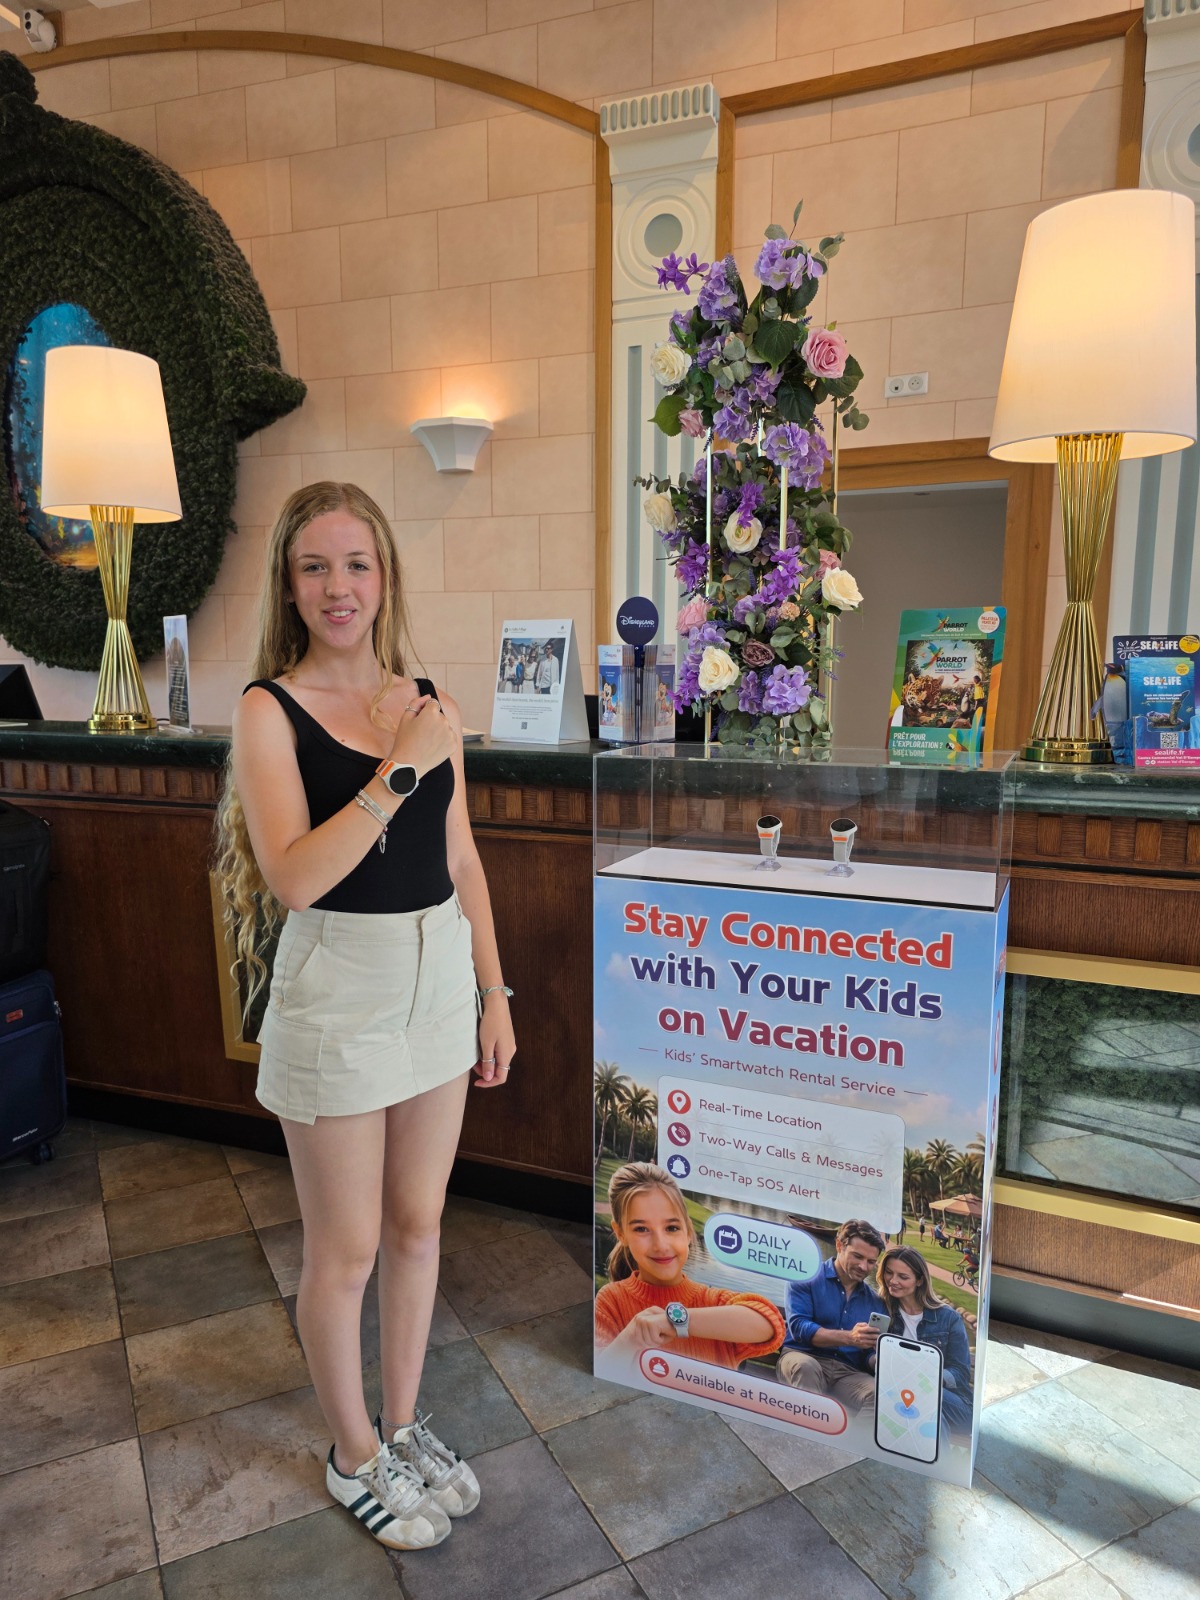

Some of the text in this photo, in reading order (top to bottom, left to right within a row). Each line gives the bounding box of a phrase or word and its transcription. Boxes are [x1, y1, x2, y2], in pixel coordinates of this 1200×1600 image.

[1140, 641, 1158, 650] SEA
[1143, 677, 1160, 686] SEA
[892, 741, 939, 749] L'EXPLORATION
[893, 732, 909, 740] PRÊT
[624, 902, 954, 970] Stay Connected
[630, 952, 942, 1020] with Your Kids
[659, 1007, 904, 1067] on Vacation
[701, 1053, 784, 1078] Smartwatch
[789, 1068, 836, 1087] Rental
[841, 1076, 896, 1097] Service
[699, 1099, 823, 1131] Real-Time Location
[699, 1132, 883, 1178] Two-Way Calls & Messages
[698, 1165, 820, 1200] One-Tap SOS Alert
[747, 1230, 791, 1252] DAILY
[747, 1250, 808, 1274] RENTAL
[675, 1368, 830, 1423] Available at Reception
